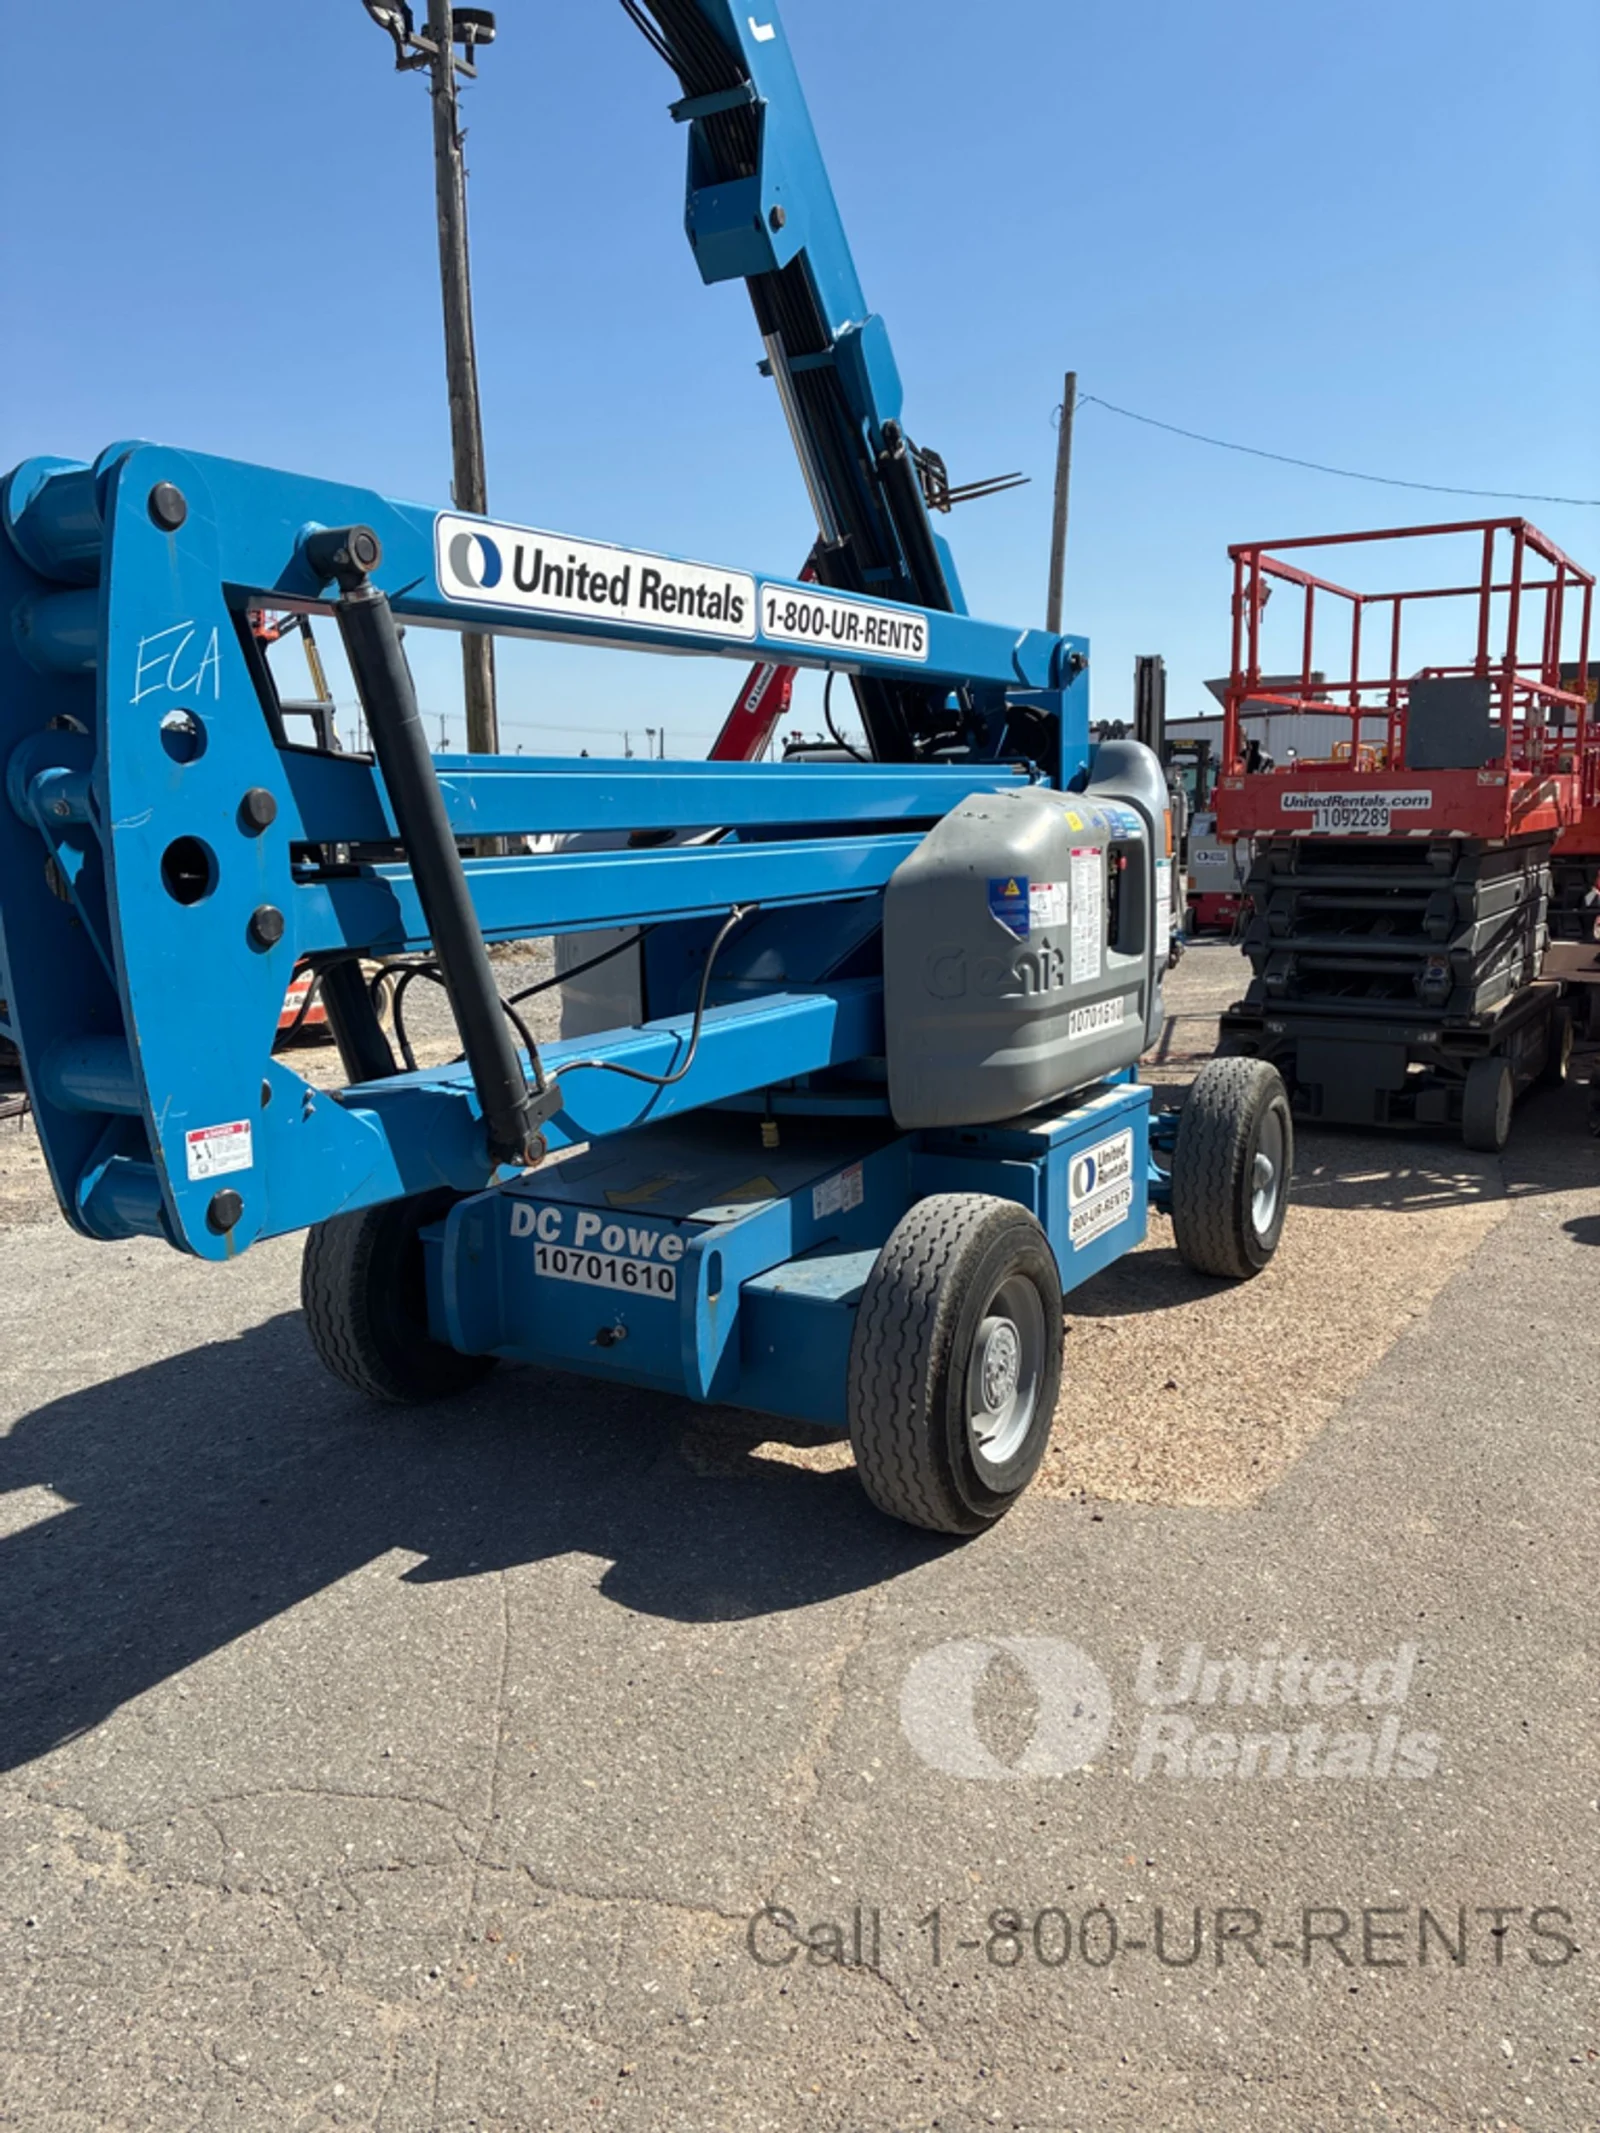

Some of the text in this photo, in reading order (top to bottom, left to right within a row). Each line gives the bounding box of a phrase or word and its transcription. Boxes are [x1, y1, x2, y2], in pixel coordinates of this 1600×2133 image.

[513, 545, 744, 624] United Rentals
[766, 598, 924, 652] 1-800-UR-RENTS
[129, 620, 224, 706] ECA
[1283, 794, 1430, 809] UnitedRentals.com
[1314, 808, 1389, 827] 11092289
[510, 1202, 692, 1263] DC Powe
[536, 1247, 674, 1294] 10701610
